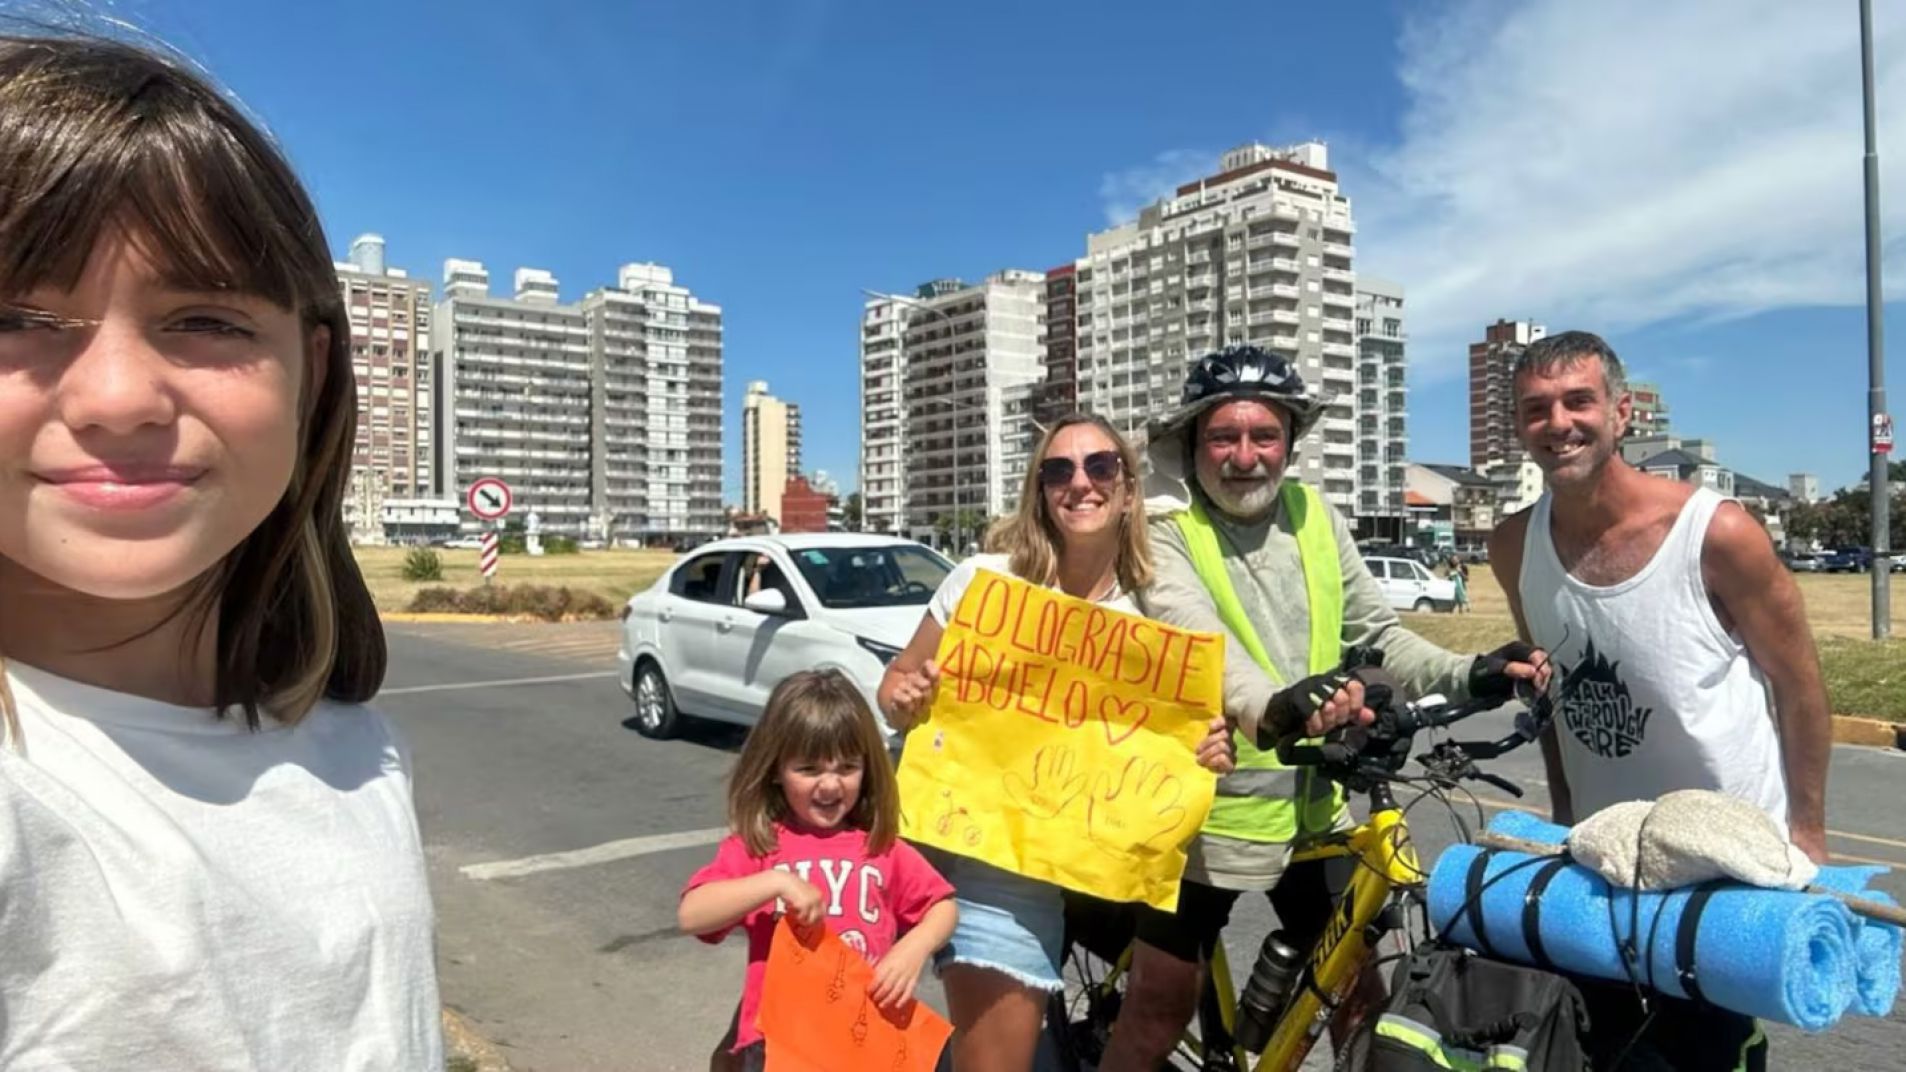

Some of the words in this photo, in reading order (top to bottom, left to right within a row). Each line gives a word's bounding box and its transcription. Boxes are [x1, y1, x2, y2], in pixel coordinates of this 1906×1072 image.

[938, 639, 1089, 729] ABUELO
[953, 578, 1009, 638] LO
[1011, 585, 1216, 709] LOGRASTE
